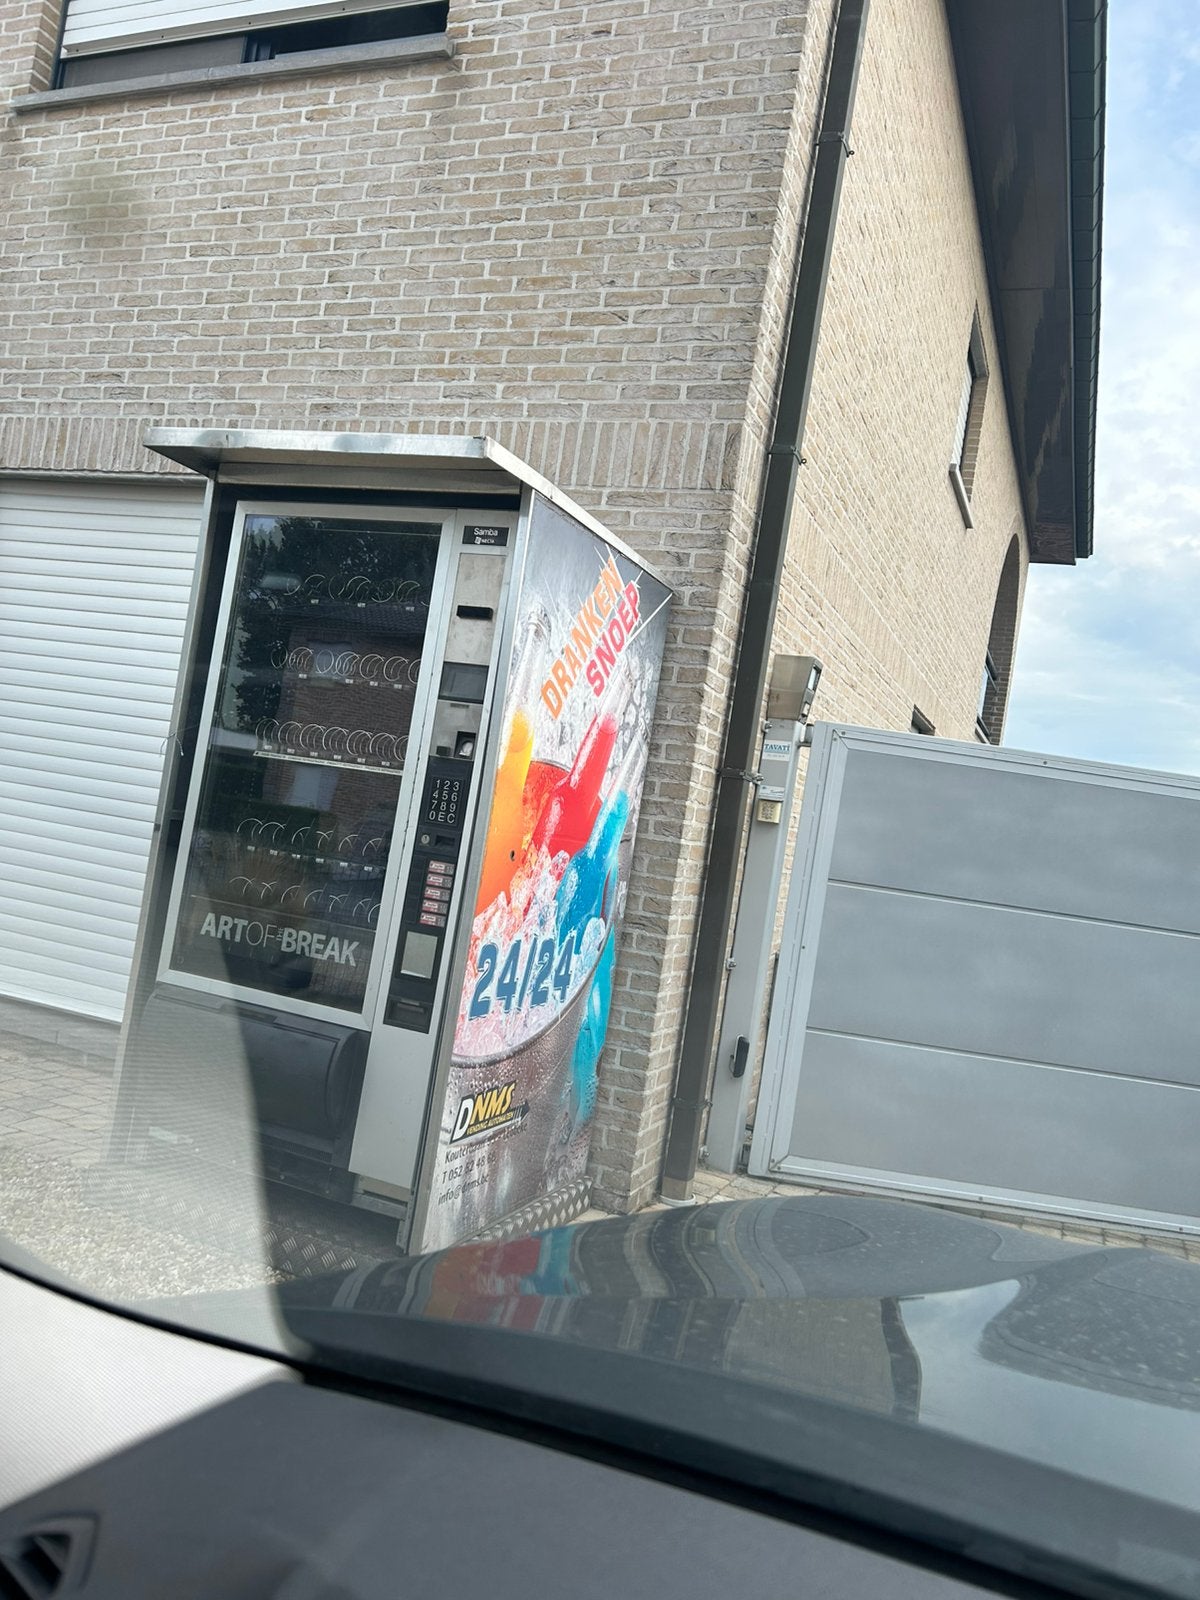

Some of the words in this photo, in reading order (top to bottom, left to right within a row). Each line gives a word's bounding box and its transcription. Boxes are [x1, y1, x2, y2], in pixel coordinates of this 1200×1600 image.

[473, 527, 498, 537] Samba
[541, 555, 622, 720] DRANKEN
[586, 580, 640, 697] SNOEP
[281, 927, 360, 968] BREAK
[468, 935, 575, 1021] 24/24
[451, 1082, 516, 1141] DNMS
